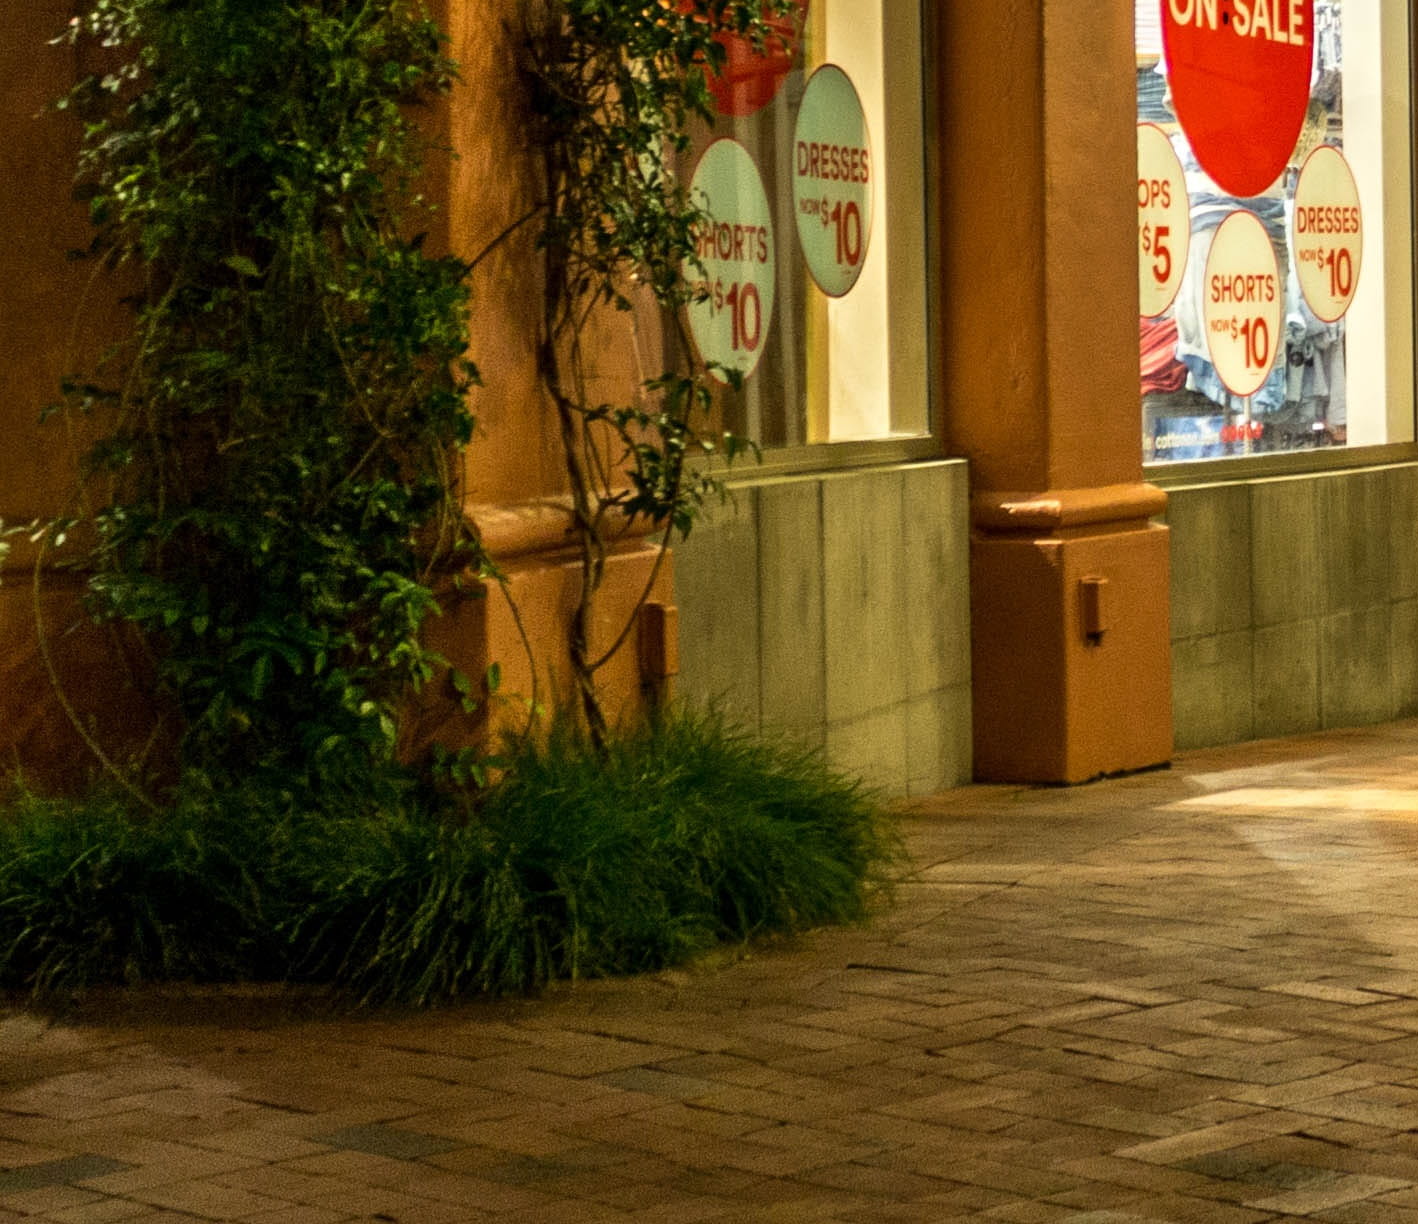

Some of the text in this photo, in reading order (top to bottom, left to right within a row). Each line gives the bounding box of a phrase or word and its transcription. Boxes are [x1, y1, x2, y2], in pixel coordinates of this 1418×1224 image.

[797, 141, 869, 183] DRESSES
[1138, 179, 1171, 208] OPS
[1297, 207, 1359, 233] DRESSES
[1211, 274, 1274, 303] SHORTS
